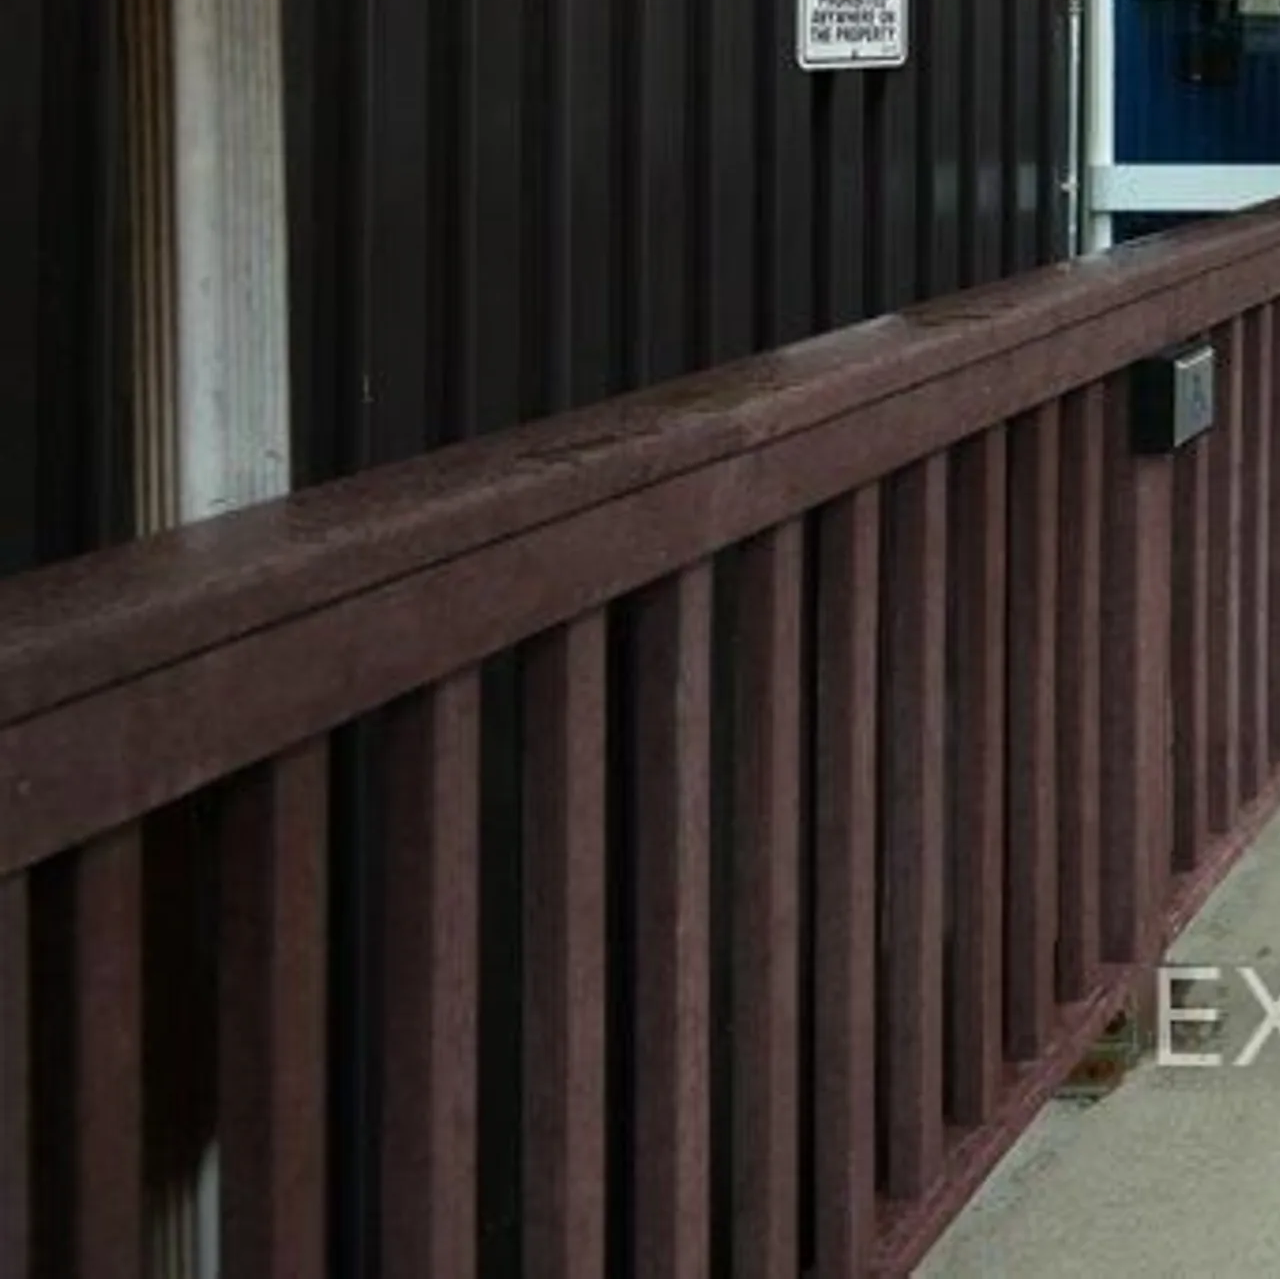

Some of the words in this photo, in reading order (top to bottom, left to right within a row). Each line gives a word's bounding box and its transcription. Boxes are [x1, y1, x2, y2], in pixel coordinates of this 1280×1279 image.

[811, 8, 875, 24] ANYWHERE
[879, 10, 896, 24] ON
[811, 25, 831, 43] THE
[836, 25, 897, 42] PROPERTY
